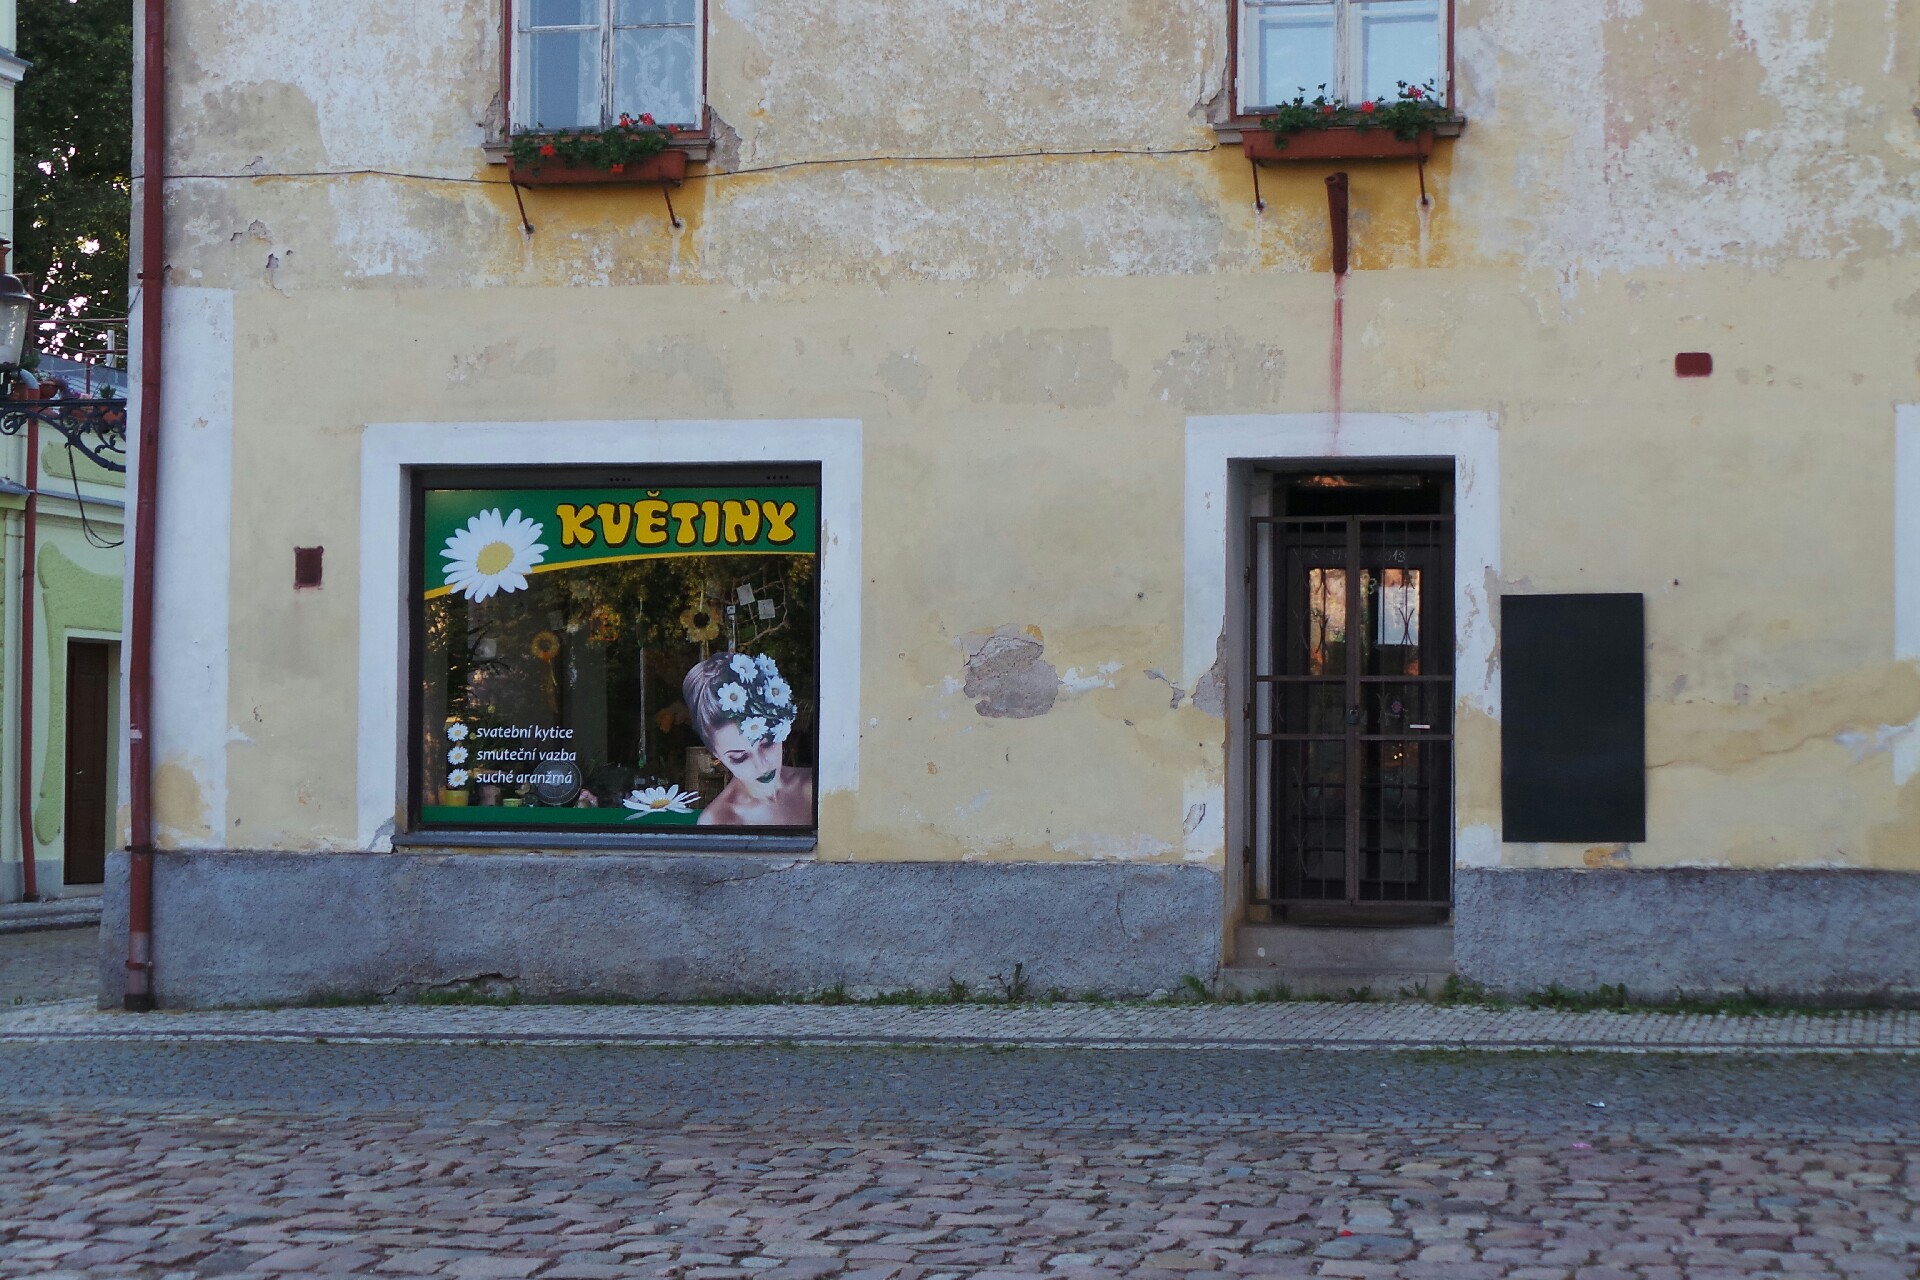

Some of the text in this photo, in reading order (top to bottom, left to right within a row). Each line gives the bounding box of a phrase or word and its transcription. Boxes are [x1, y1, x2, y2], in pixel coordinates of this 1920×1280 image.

[555, 490, 798, 548] KVĚTINY
[476, 725, 574, 742] svatební kytice
[476, 748, 577, 761] smuteční vazba
[476, 770, 573, 784] suché aranžmá
